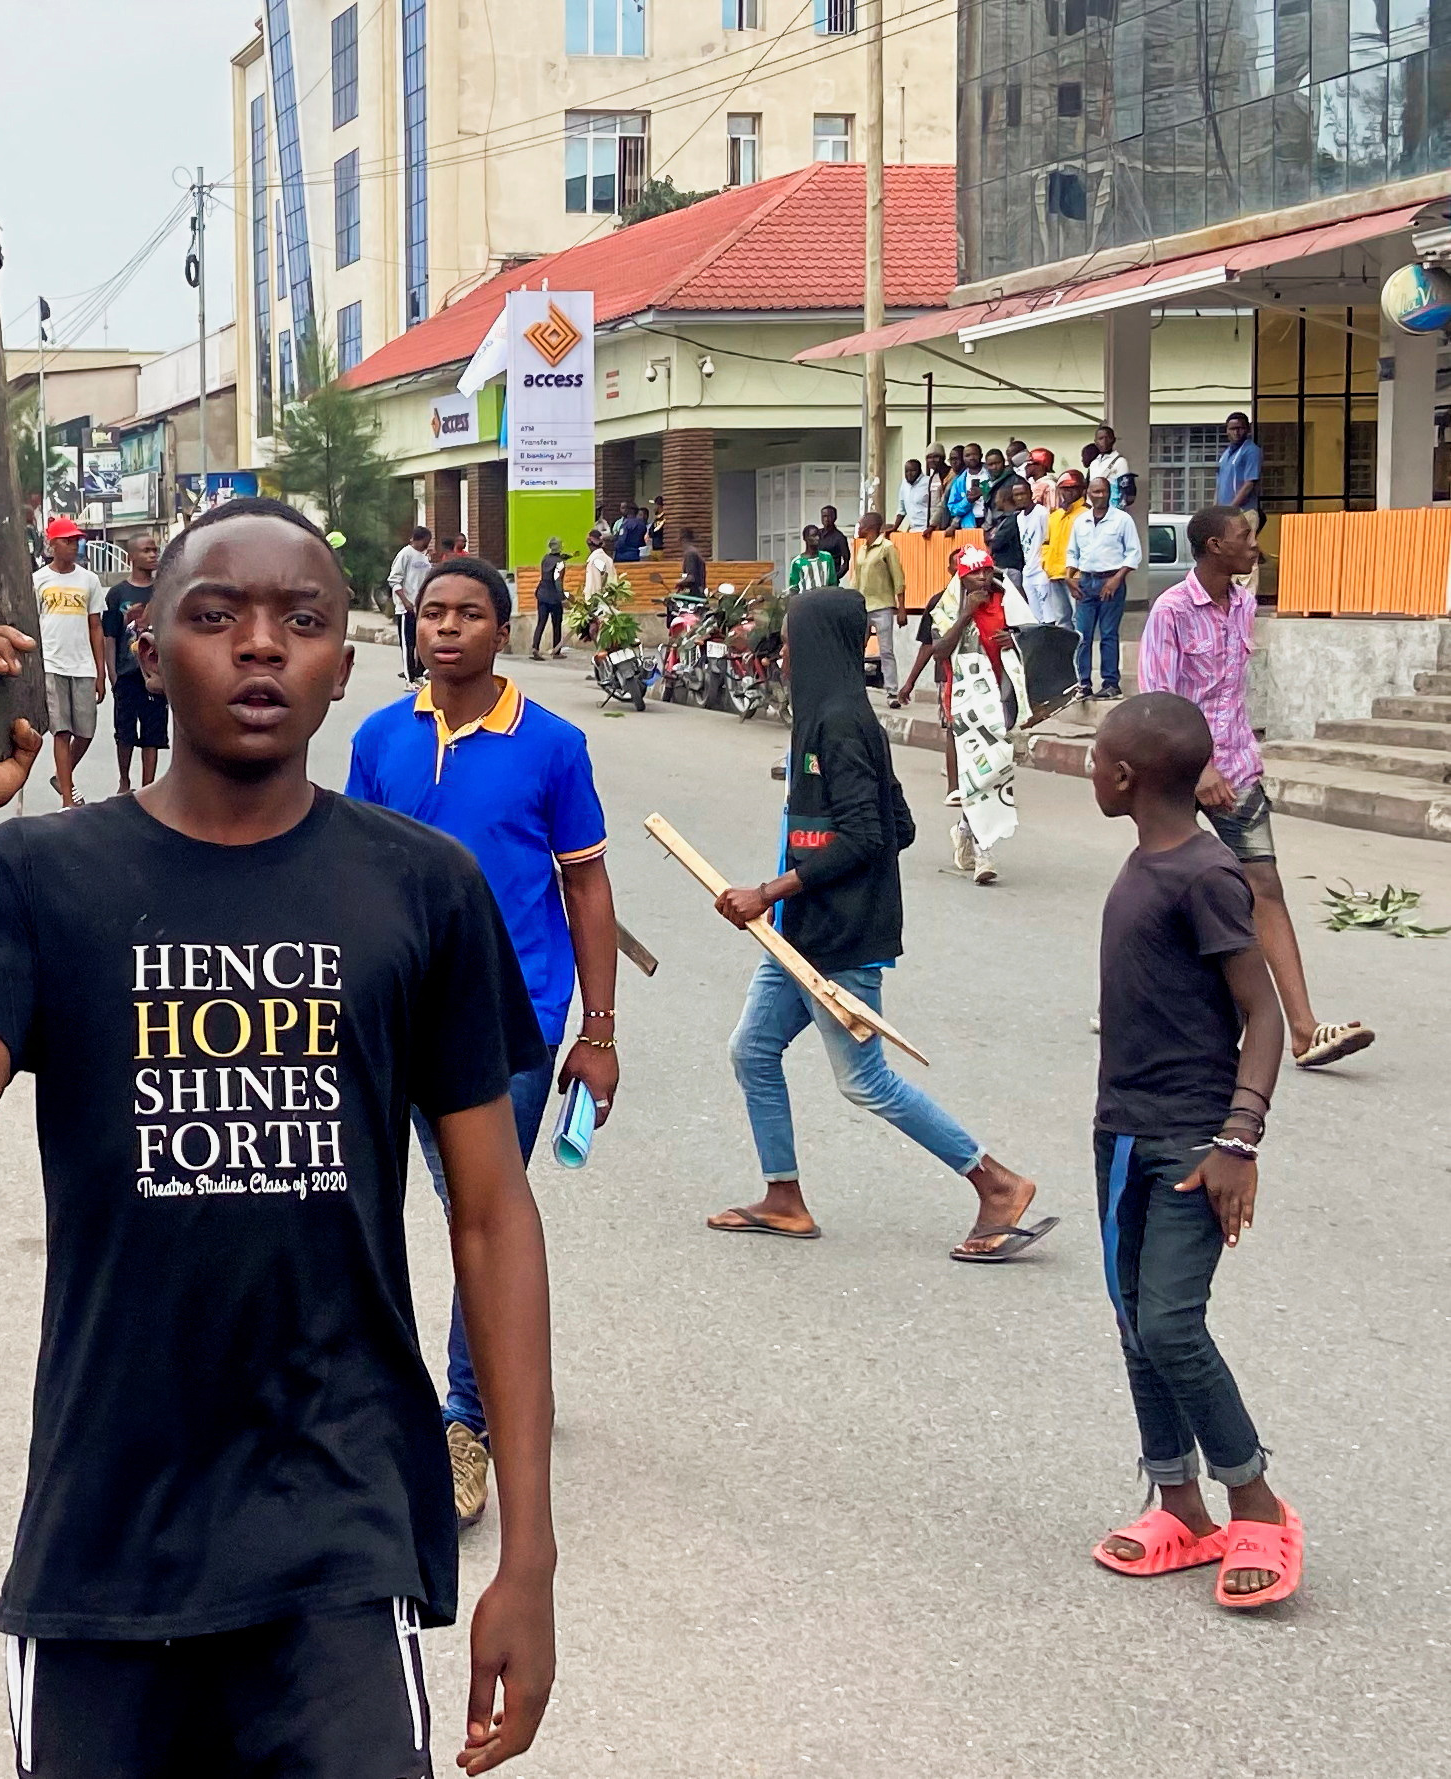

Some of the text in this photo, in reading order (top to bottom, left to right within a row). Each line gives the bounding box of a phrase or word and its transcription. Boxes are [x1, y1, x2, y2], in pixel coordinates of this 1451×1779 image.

[523, 373, 584, 388] access
[441, 412, 470, 434] access
[520, 438, 558, 446] Transferts
[526, 452, 555, 461] banking
[556, 452, 573, 460] 24/7
[131, 941, 343, 992] HENCE
[132, 998, 342, 1060] HOPE
[134, 1064, 341, 1115] SHINES
[135, 1120, 345, 1173] FORTH
[136, 1171, 347, 1201] Theatre Studies Class of 2020
